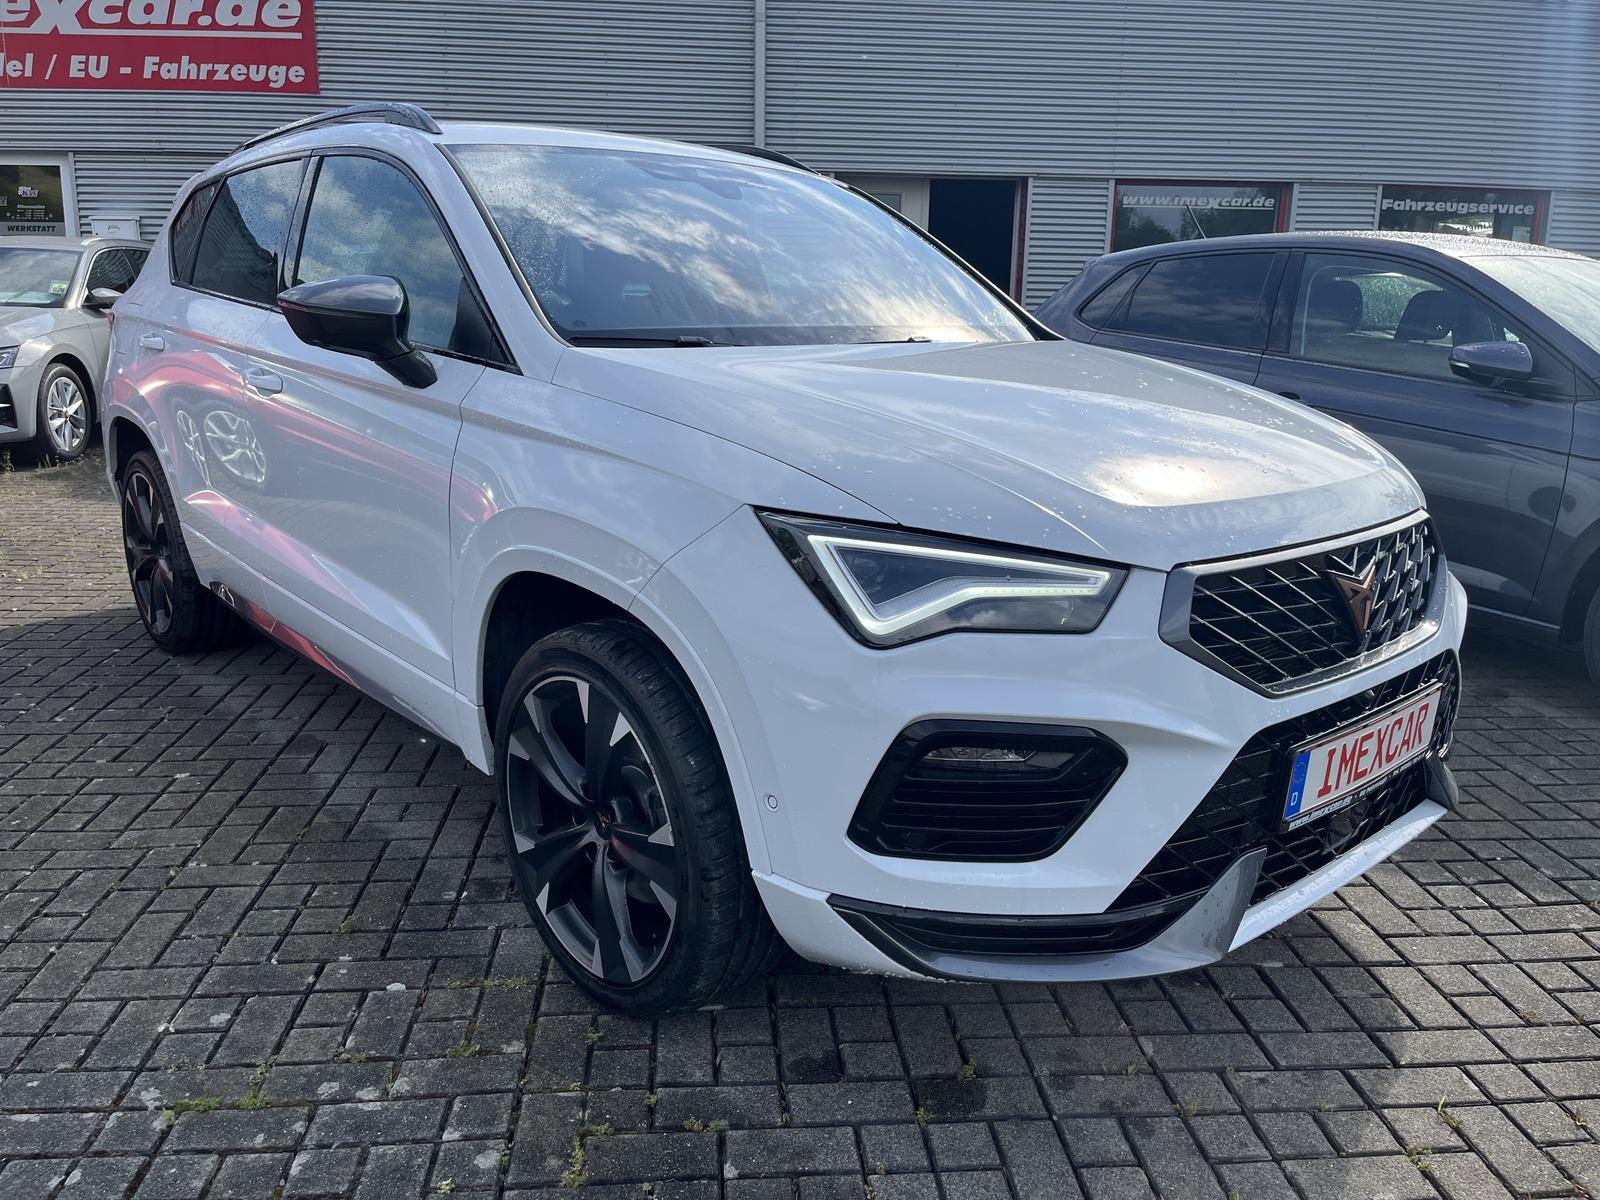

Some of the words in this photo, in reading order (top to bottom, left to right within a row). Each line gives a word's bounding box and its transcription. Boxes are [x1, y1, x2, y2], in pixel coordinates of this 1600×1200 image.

[69, 55, 109, 78] EU
[143, 55, 306, 88] Fahrzeuge
[1122, 195, 1276, 210] www.imexcar.de
[1381, 198, 1535, 215] Fahrzeugservice
[7, 225, 56, 233] WERKSTATT
[1290, 791, 1299, 807] D
[1317, 702, 1430, 798] IMEXCAR
